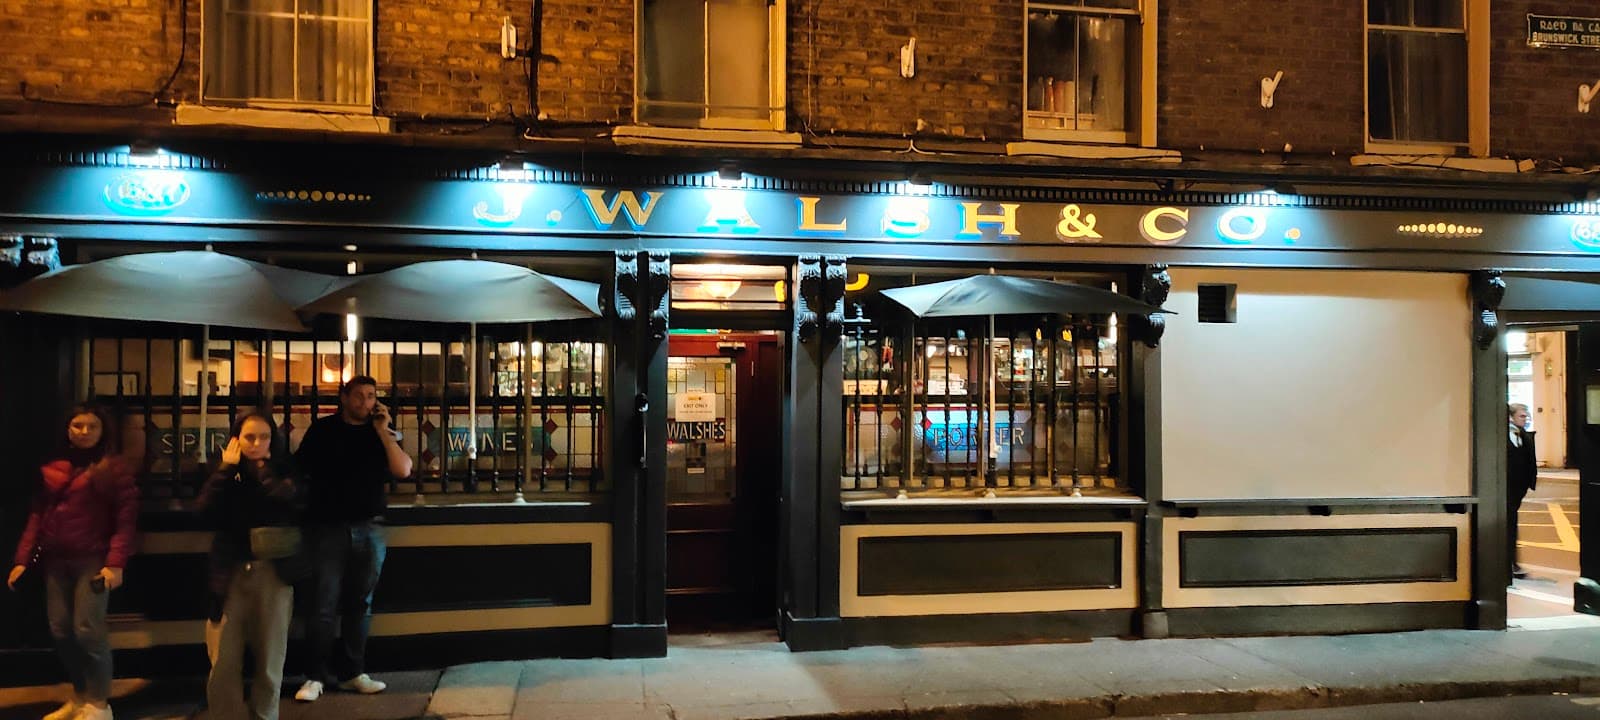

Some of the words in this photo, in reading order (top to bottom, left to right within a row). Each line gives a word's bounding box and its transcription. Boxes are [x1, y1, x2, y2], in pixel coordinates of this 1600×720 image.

[1532, 31, 1579, 43] BRUNSWICK
[1055, 203, 1104, 243] &
[667, 422, 725, 440] WALSHES
